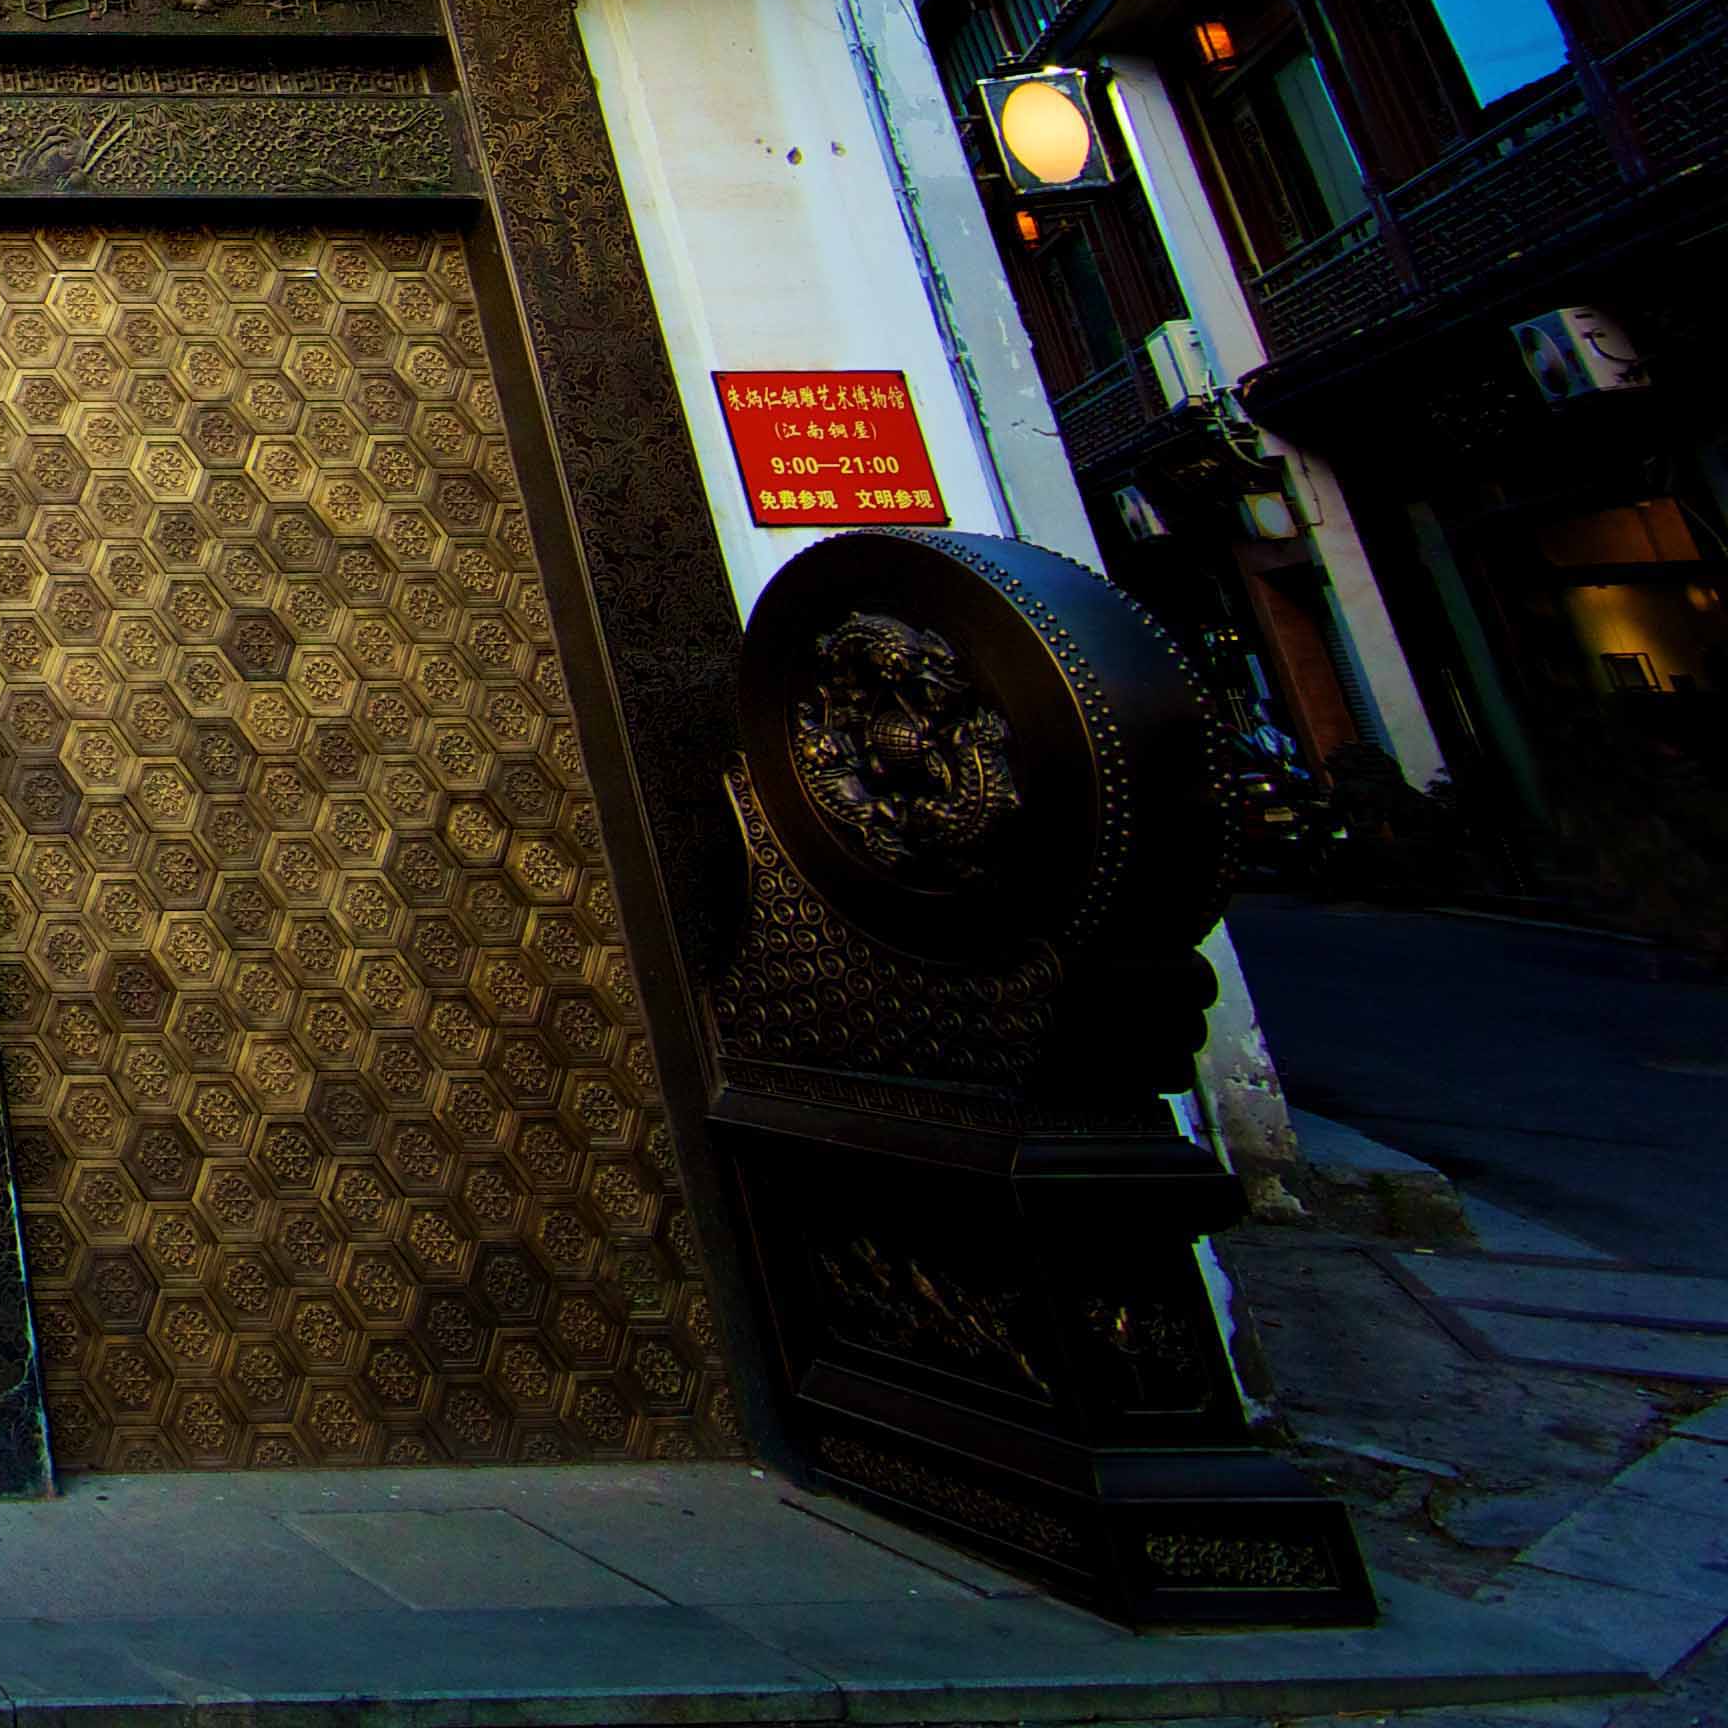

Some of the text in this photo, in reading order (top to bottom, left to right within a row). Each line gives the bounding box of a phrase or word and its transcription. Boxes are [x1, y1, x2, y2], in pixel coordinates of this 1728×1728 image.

[758, 489, 935, 510] 免费参观 文明参观
